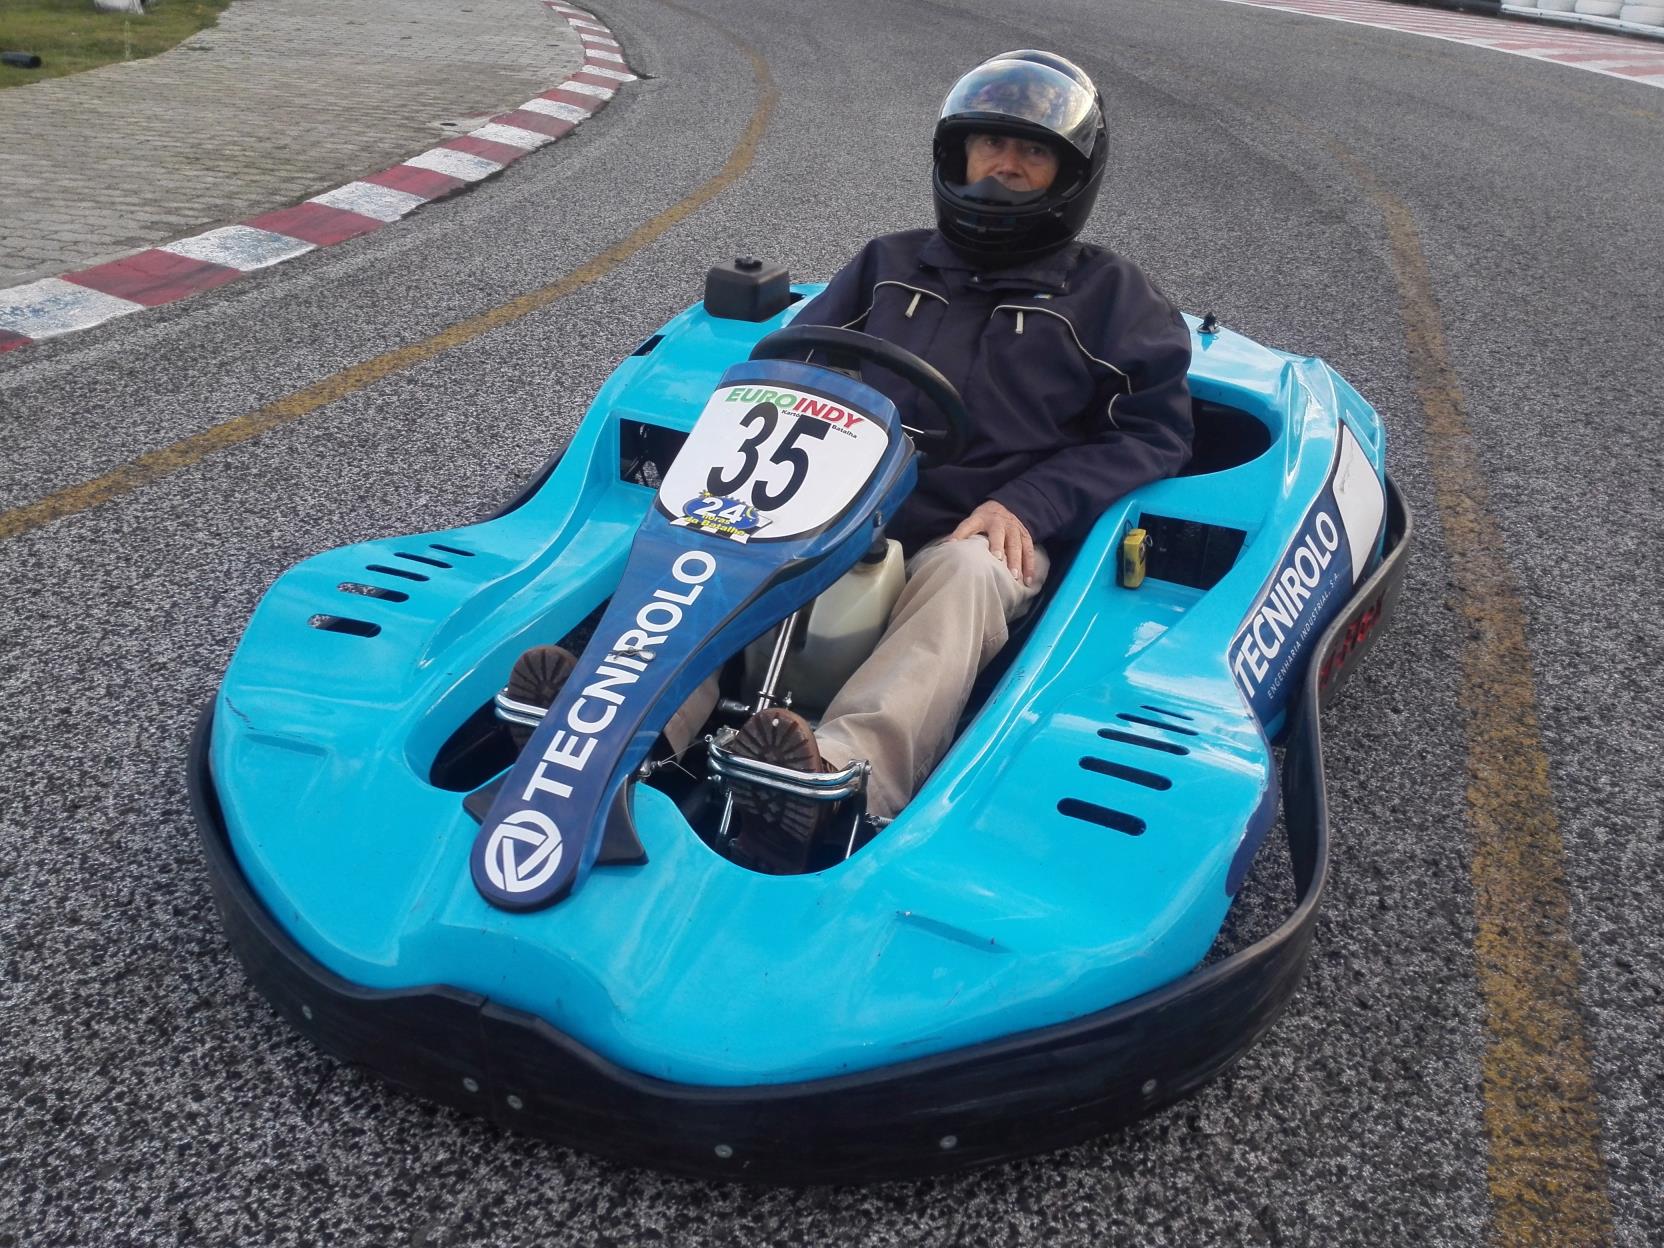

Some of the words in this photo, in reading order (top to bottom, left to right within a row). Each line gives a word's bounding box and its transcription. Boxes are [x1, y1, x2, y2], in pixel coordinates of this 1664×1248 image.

[706, 402, 831, 512] 35
[831, 424, 858, 439] Batalha
[693, 497, 746, 525] 24
[702, 511, 732, 524] horas
[1234, 511, 1339, 698] TECNIROLO
[521, 550, 717, 801] TECNIROLO
[1267, 640, 1301, 700] ENGENHARIA
